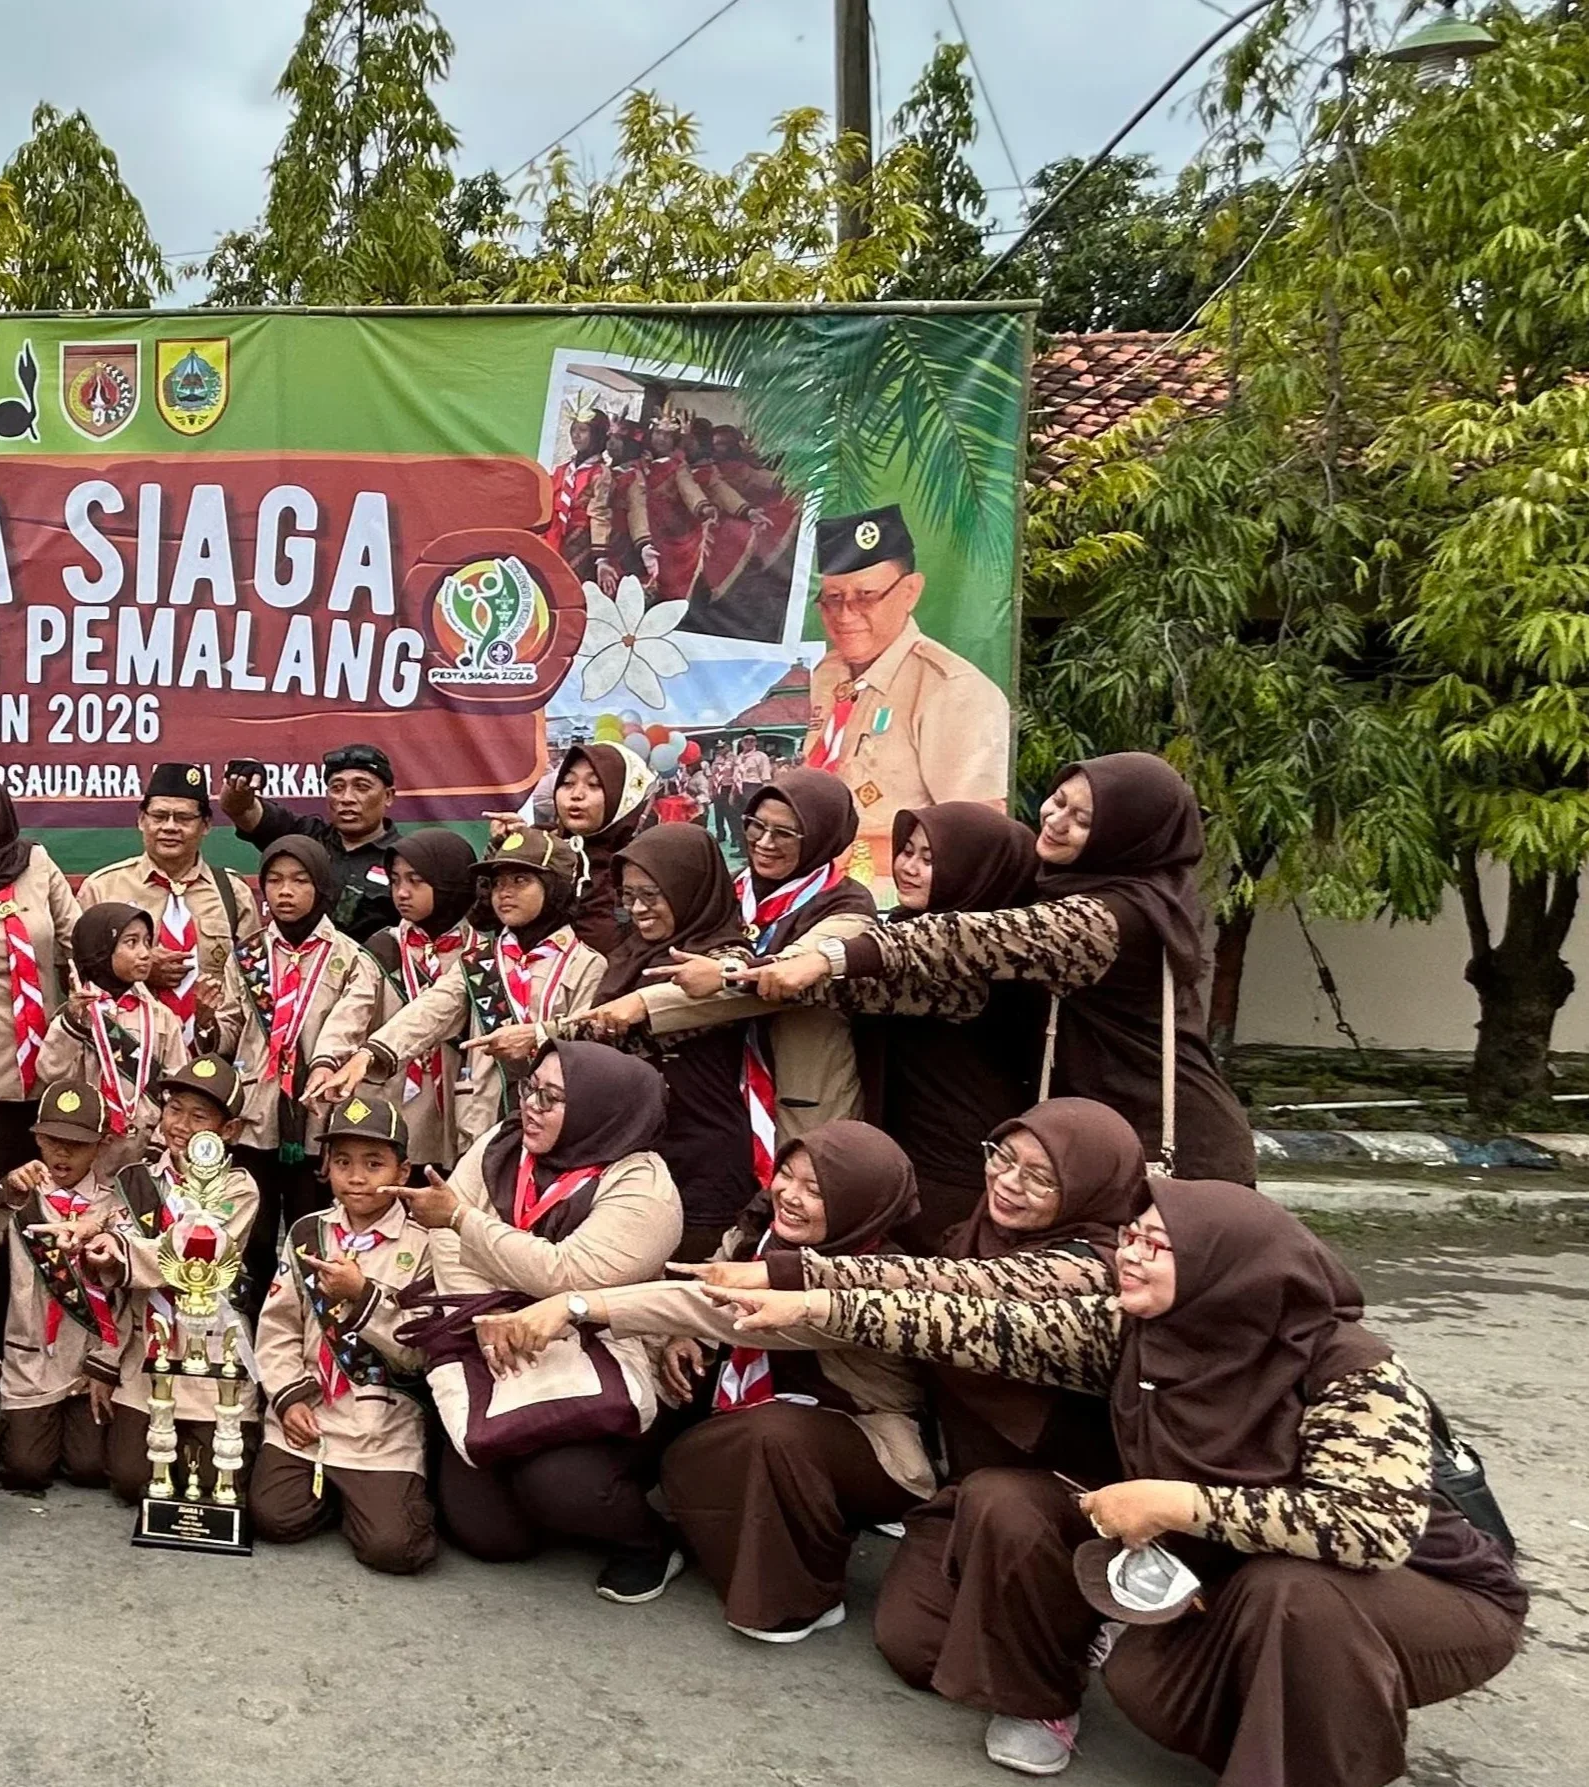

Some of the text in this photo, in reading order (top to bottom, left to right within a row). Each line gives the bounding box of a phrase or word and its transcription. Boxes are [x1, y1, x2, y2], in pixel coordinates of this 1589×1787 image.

[61, 479, 396, 616] SIAGA
[25, 605, 426, 708] PEMALANG
[431, 670, 534, 681] PESTA SIAGA 2026
[47, 692, 160, 744] 2026
